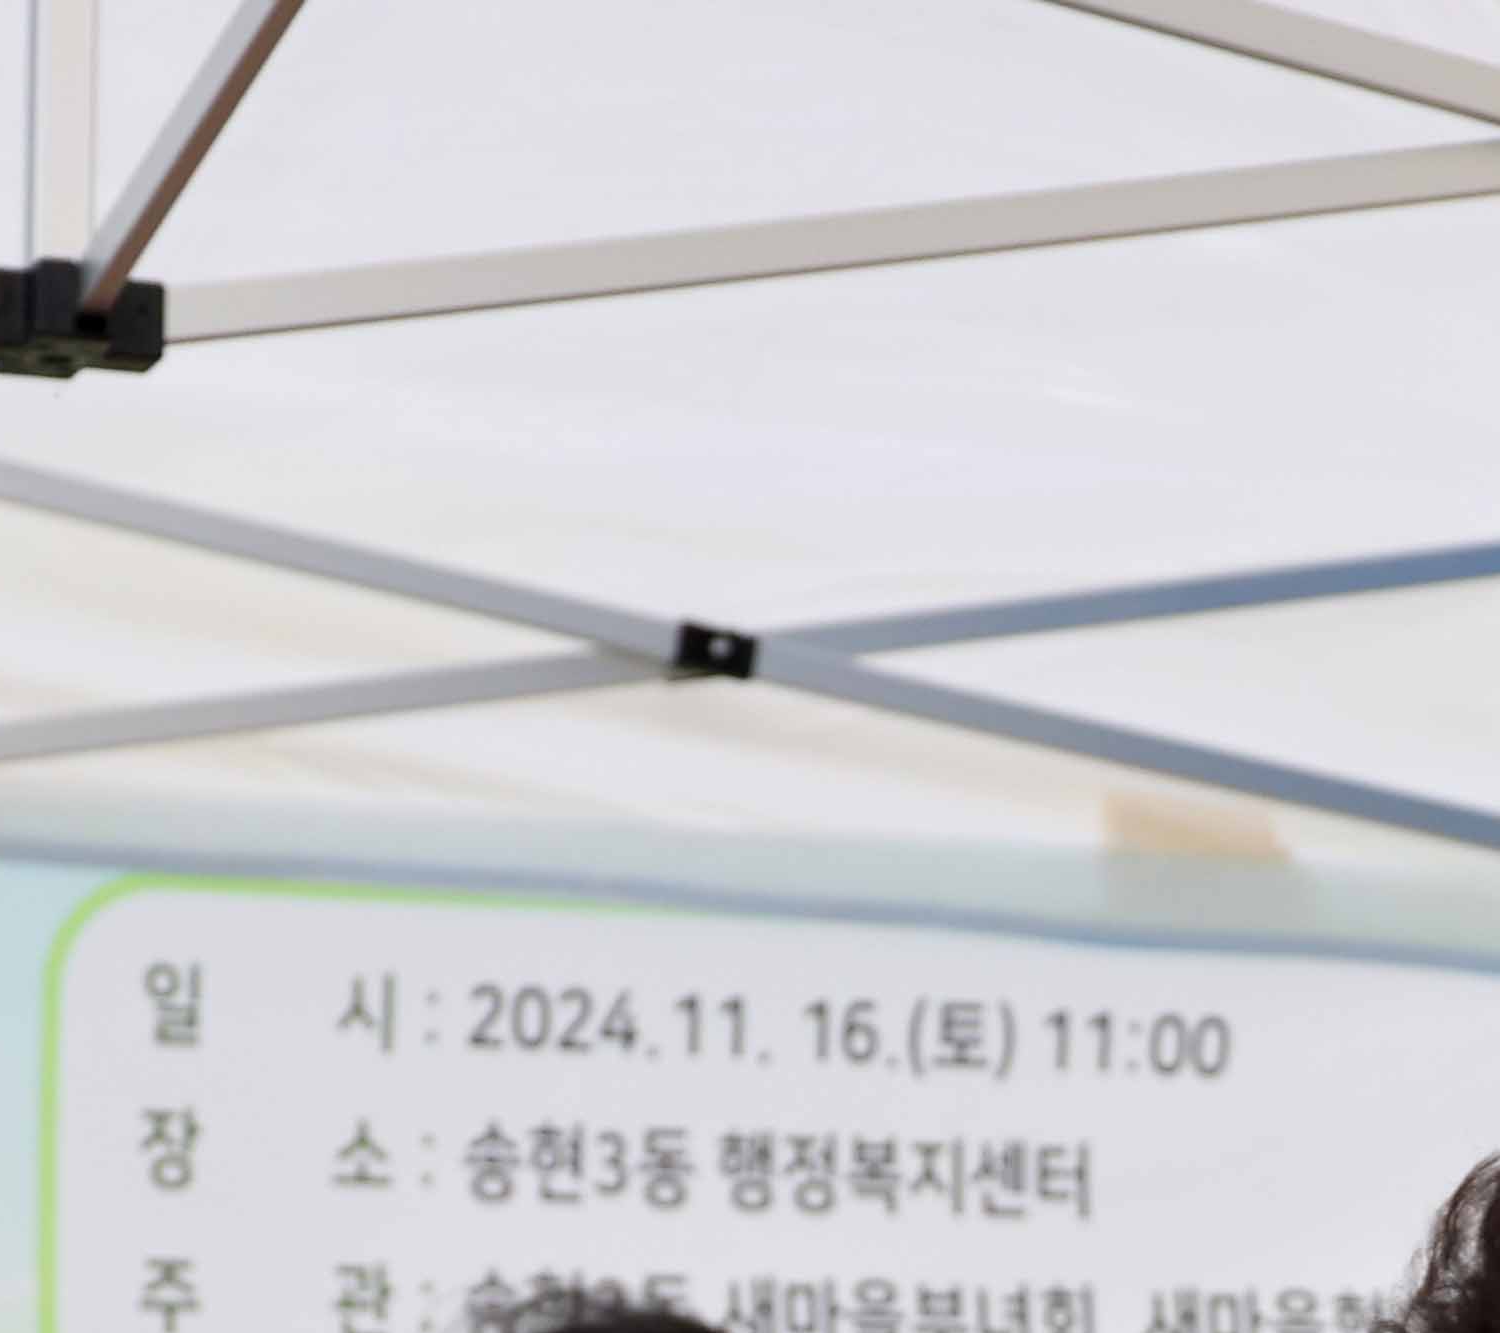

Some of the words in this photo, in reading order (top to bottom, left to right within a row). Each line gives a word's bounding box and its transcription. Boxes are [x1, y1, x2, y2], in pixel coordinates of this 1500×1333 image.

[143, 961, 202, 1048] 일
[335, 970, 398, 1056] 시
[1046, 1010, 1232, 1078] 11:00
[140, 1107, 202, 1190] 장
[332, 1117, 393, 1188] 소
[464, 1120, 693, 1210] 송현3동
[716, 1132, 1092, 1220] 행정복지센터
